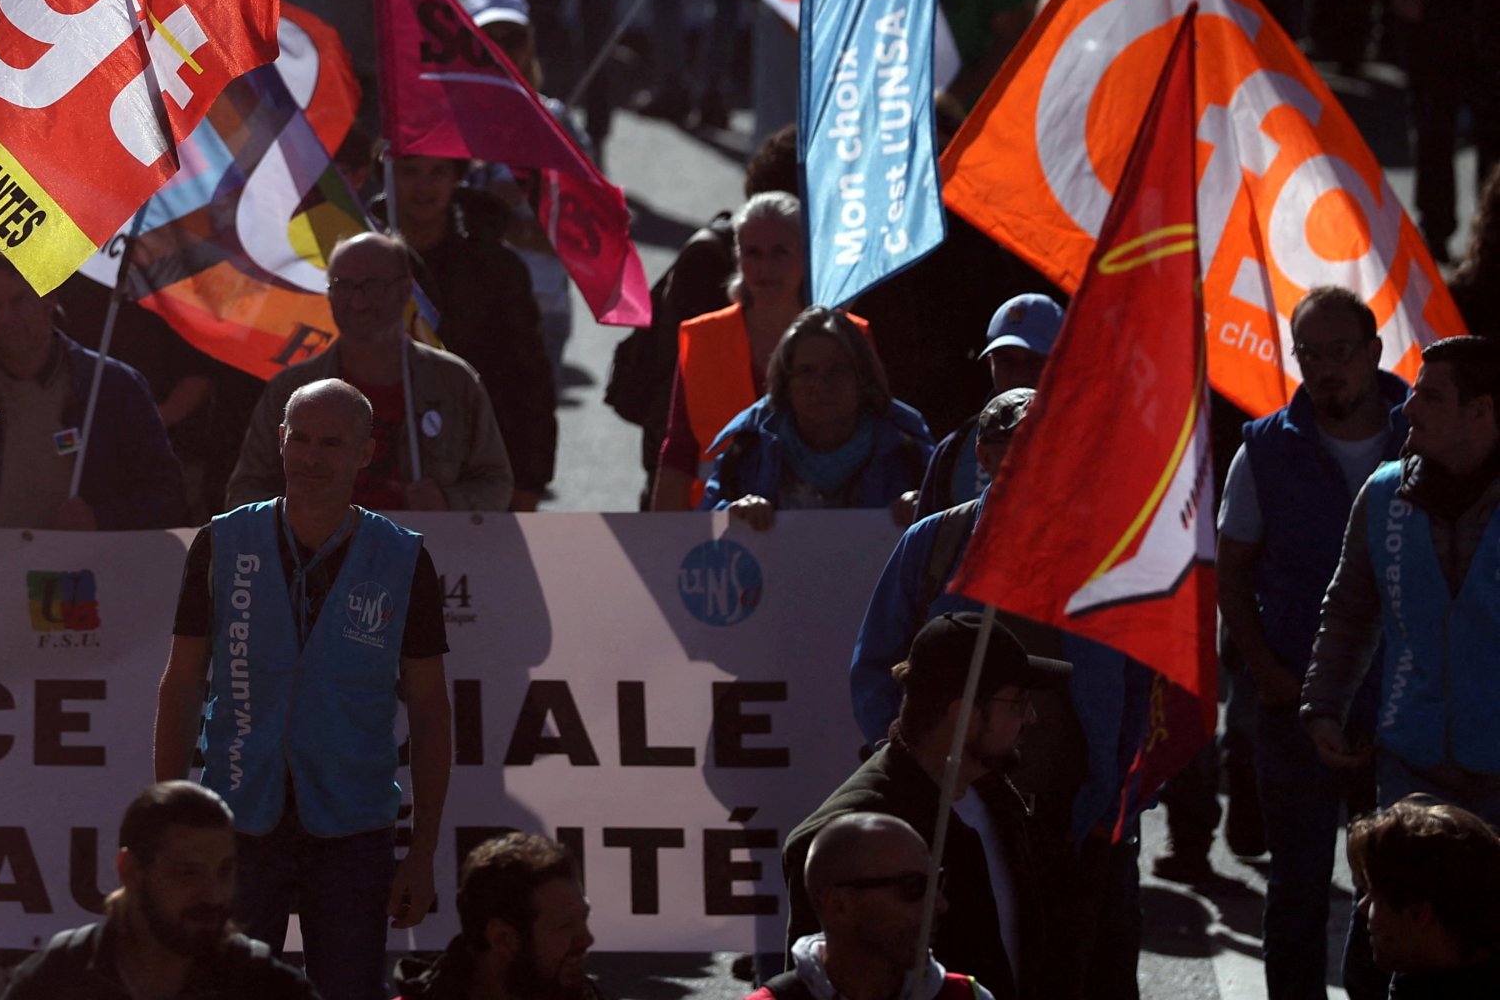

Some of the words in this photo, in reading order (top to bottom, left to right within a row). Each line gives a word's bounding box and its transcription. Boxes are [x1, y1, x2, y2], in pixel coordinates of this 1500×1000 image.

[828, 44, 863, 163] choix
[874, 6, 912, 157] l'UNSA
[833, 173, 868, 267] Mon
[228, 552, 261, 791] www.unsa.org
